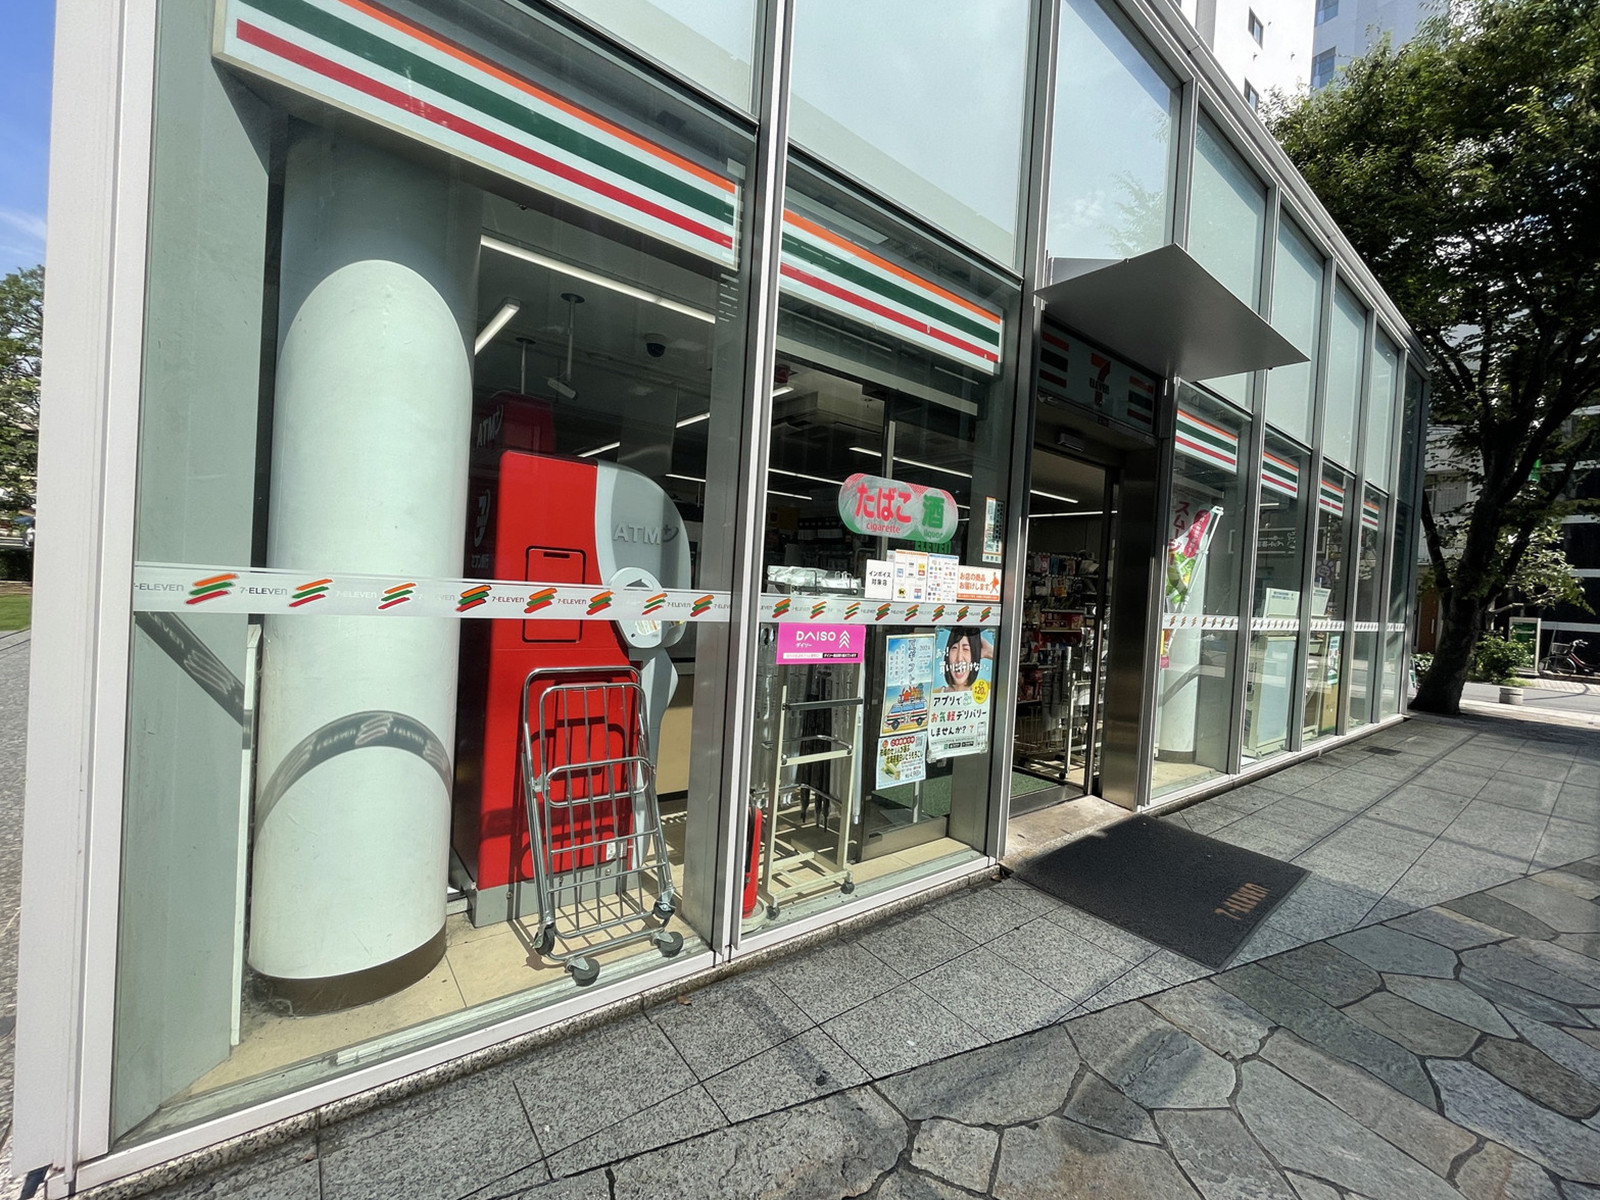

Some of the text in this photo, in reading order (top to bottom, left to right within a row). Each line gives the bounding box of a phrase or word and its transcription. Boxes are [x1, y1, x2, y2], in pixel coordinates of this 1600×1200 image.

[855, 482, 912, 524] たばこ
[921, 494, 946, 529] 酒
[866, 522, 901, 535] cigarette
[924, 529, 944, 540] liquor
[613, 525, 661, 546] ATM
[869, 570, 891, 578] インボイス
[959, 571, 986, 582] お店の商品
[796, 630, 837, 642] DAISO
[933, 695, 963, 707] アプリで
[930, 709, 987, 723] お気軽デリバリー
